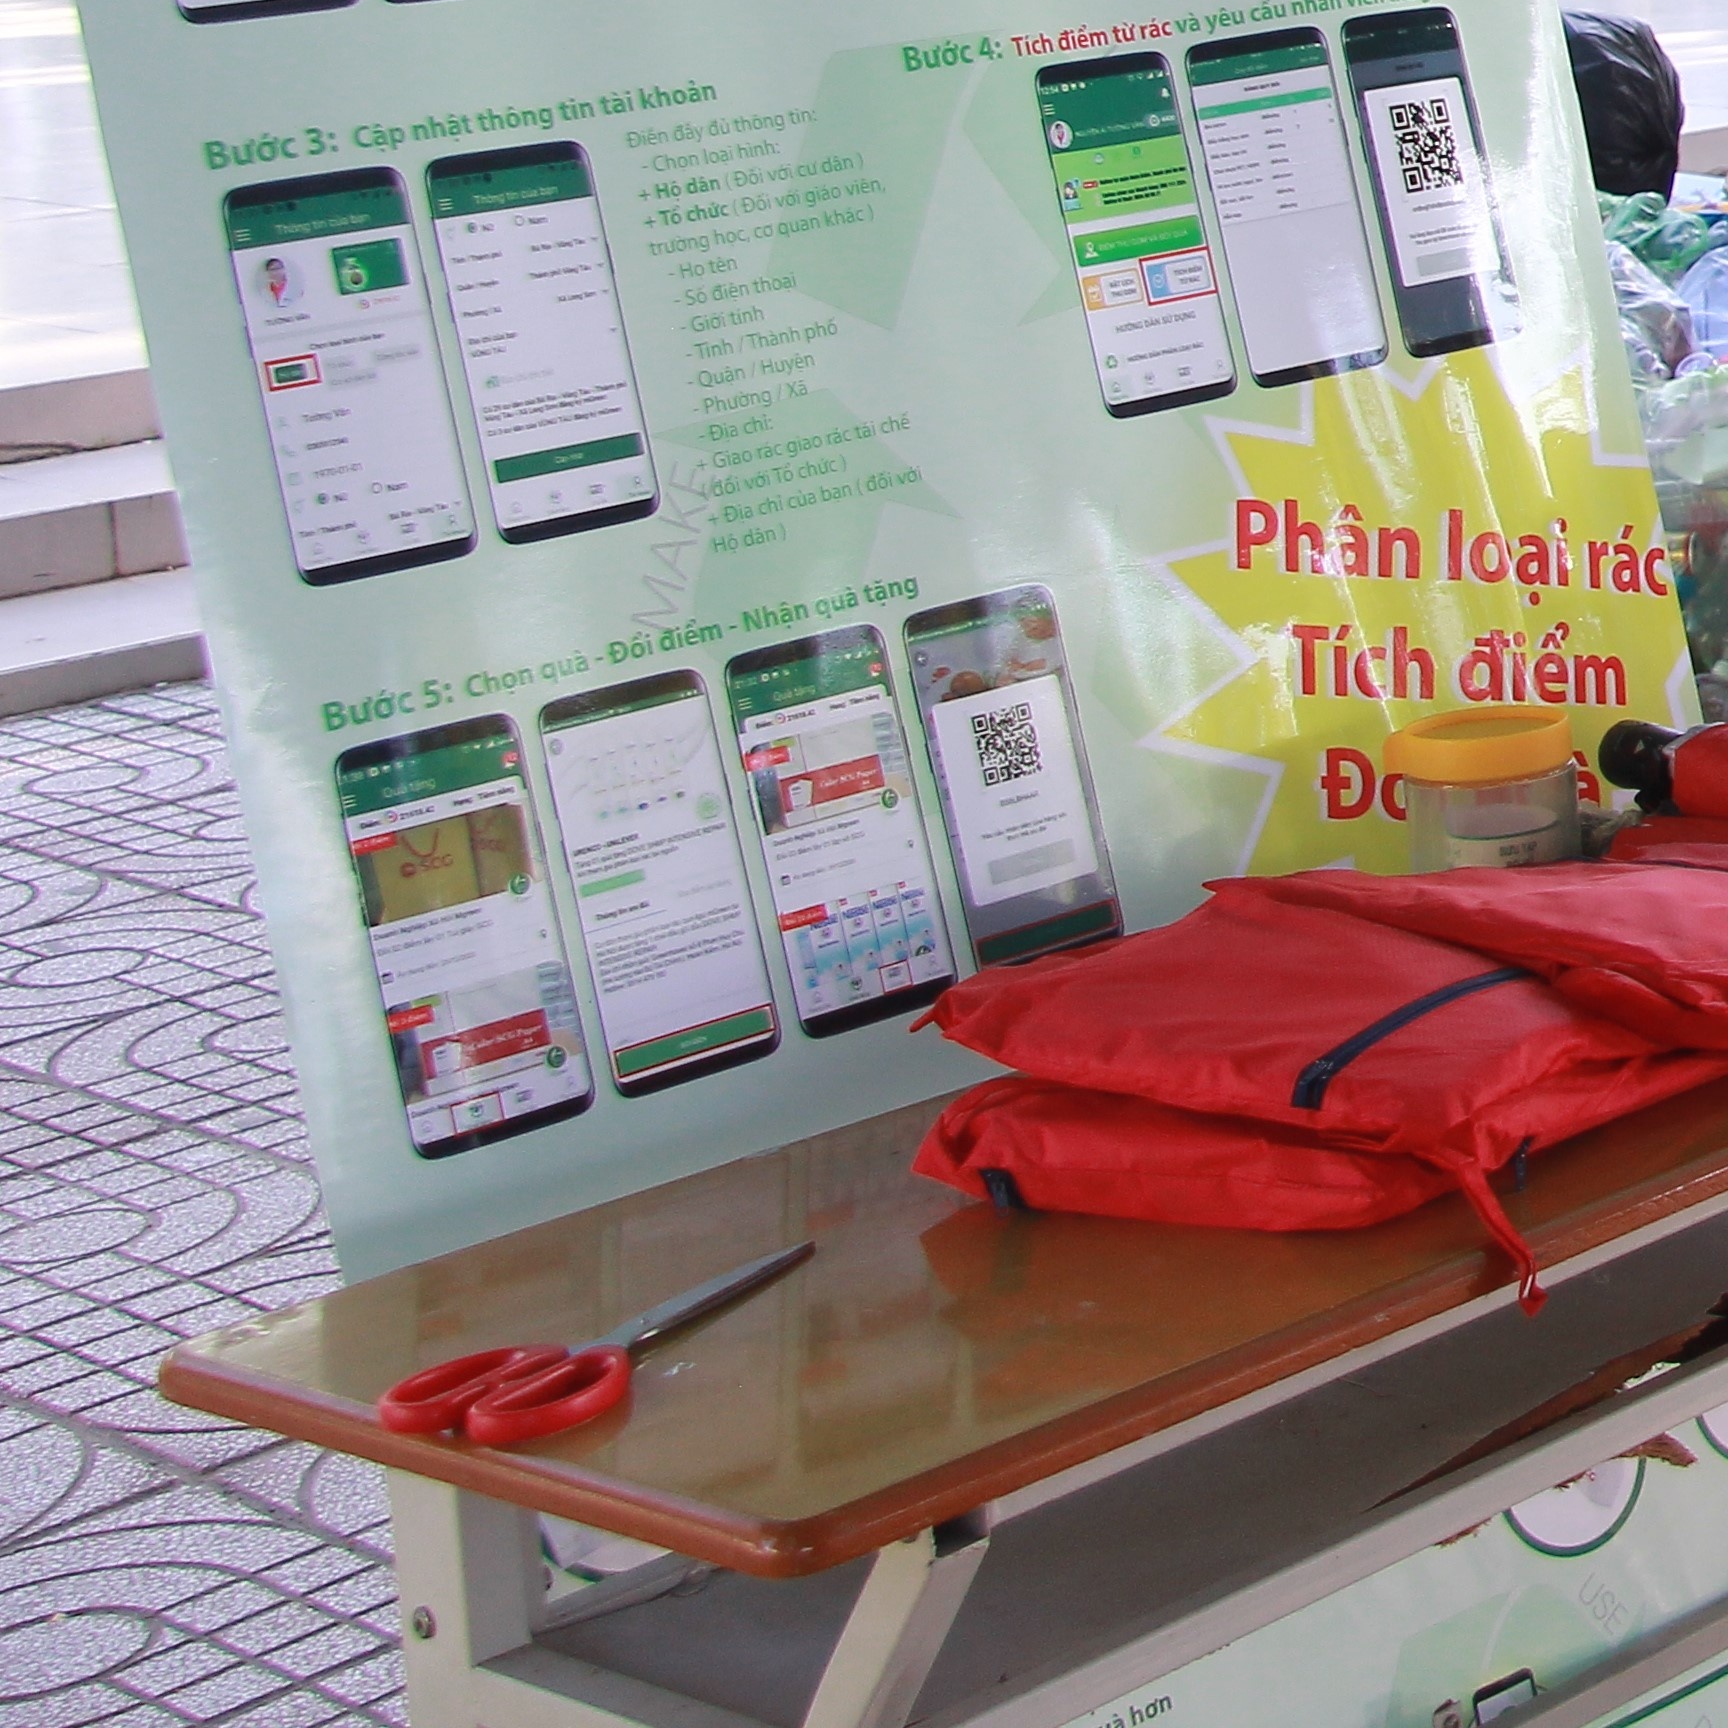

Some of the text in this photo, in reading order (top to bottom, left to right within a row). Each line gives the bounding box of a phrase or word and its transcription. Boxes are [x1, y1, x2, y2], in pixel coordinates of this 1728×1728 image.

[902, 41, 973, 73] Bước
[978, 37, 1004, 63] 4:
[1011, 29, 1055, 59] Tích
[1058, 24, 1109, 53] điểm
[1113, 17, 1138, 44] từ
[1139, 15, 1174, 40] rác
[1175, 10, 1202, 35] và
[1205, 3, 1247, 32] yêu
[206, 80, 717, 169] Bước 3: Cập nhật thông tin tài khoản
[685, 273, 797, 306] Số điện thoại
[1233, 498, 1668, 606] Phân loại rác
[321, 575, 919, 733] Bước 5: Chọn quà Đổi điểm Nhận quà tặng
[1292, 620, 1627, 707] Tích điểm
[1129, 1695, 1172, 1726] hơn
